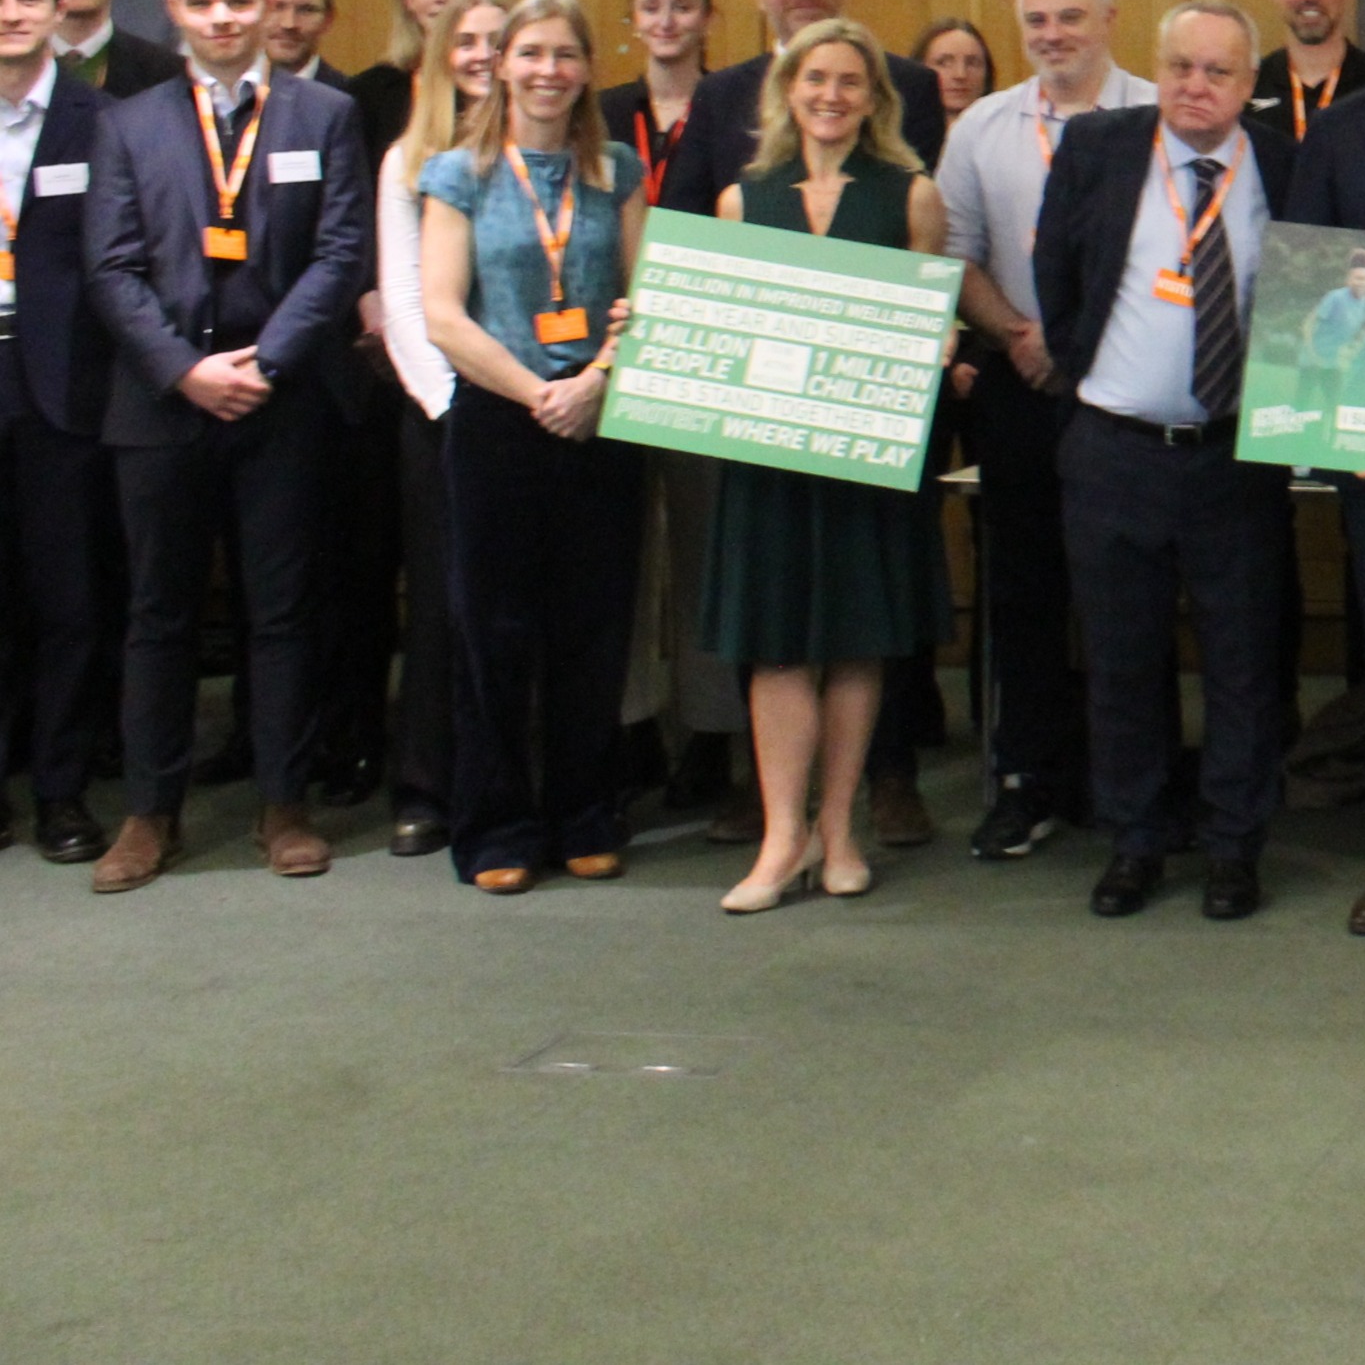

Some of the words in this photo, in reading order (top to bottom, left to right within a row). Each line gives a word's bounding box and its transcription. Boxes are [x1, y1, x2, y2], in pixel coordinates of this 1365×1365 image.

[649, 294, 707, 322] EACH
[712, 305, 767, 332] YEAR
[772, 316, 819, 342] AND
[824, 325, 926, 360] SUPPORT
[666, 271, 734, 296] BILLION
[734, 283, 755, 300] IN
[755, 287, 846, 316] IMPROVED
[846, 303, 945, 333] WELLBEING
[628, 318, 648, 340] 4
[649, 322, 754, 359] MILLION
[636, 344, 735, 380] PEOPLE
[805, 374, 930, 414] CHILDREN
[812, 350, 830, 372] 1
[831, 354, 935, 391] MILLION
[632, 372, 692, 400] LET'S
[696, 384, 765, 413] STAND
[768, 396, 875, 432] TOGETHER
[880, 416, 909, 438] TO
[612, 396, 721, 434] PROTECT
[720, 415, 808, 450] WHERE
[808, 431, 852, 458] WE
[848, 438, 917, 469] PLAY
